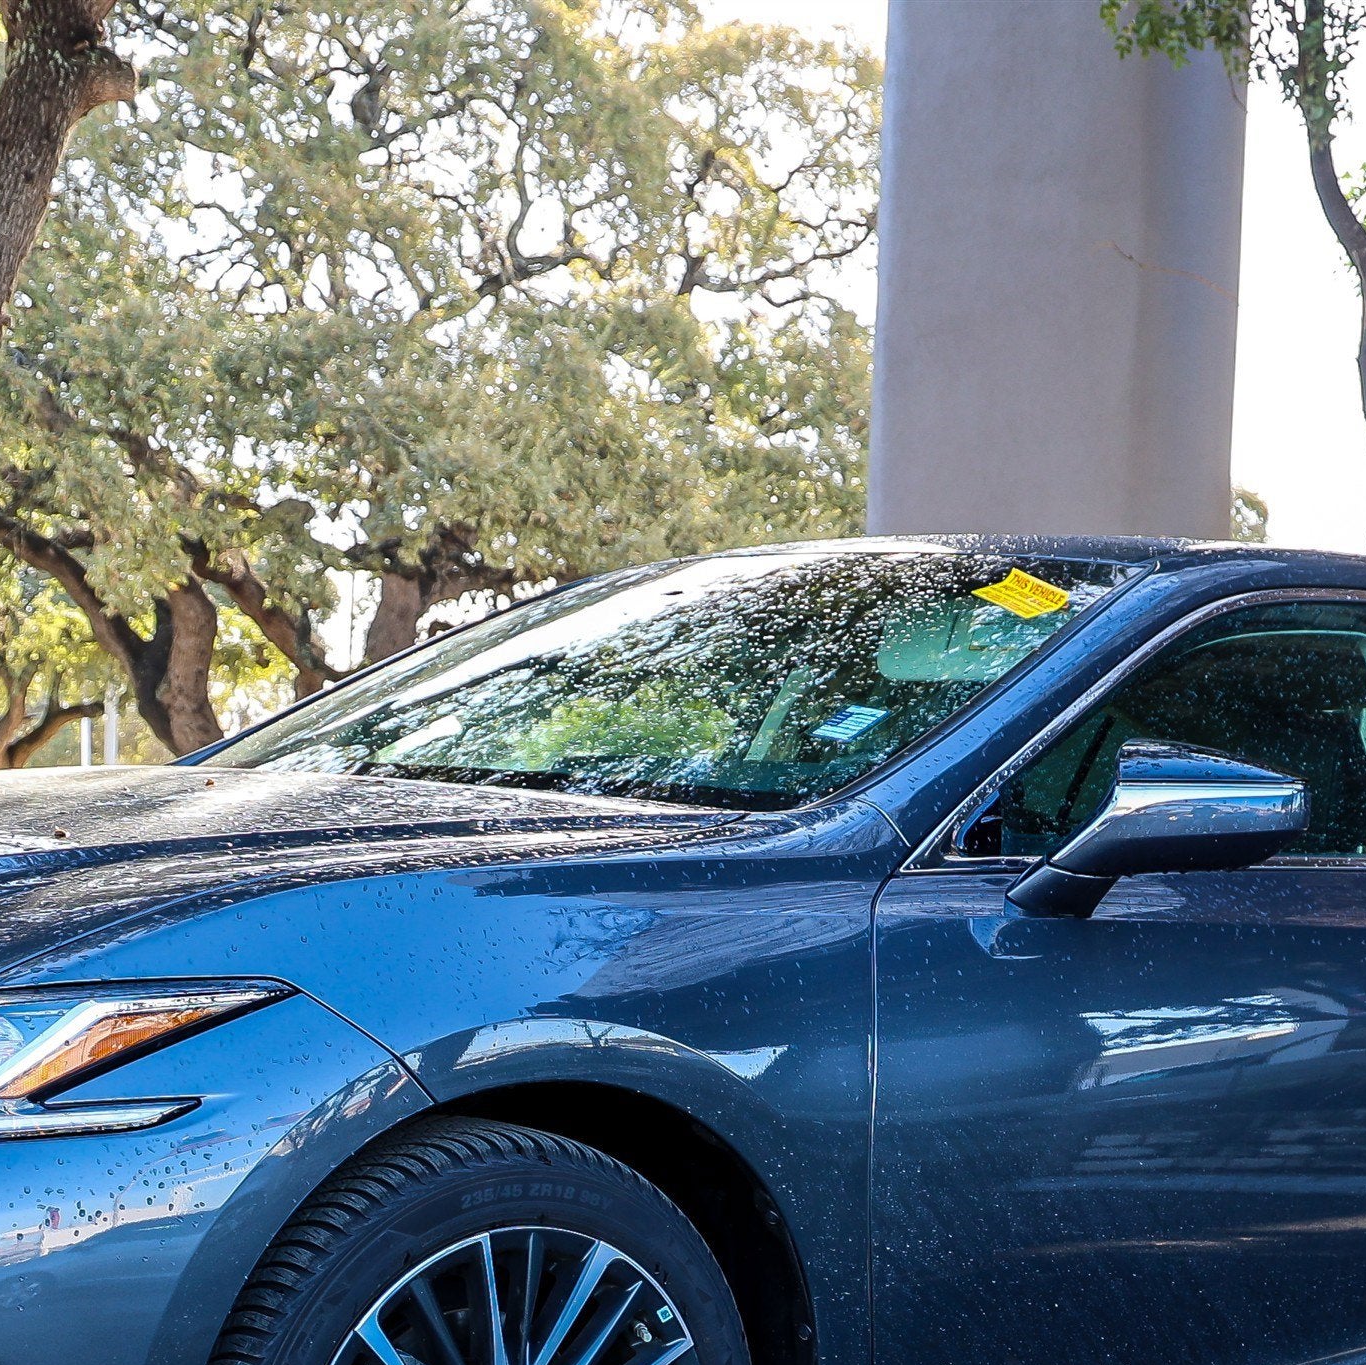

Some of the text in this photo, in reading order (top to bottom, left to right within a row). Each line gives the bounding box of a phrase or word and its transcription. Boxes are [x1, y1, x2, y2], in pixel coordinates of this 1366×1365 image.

[1009, 573, 1031, 589] THIS
[1029, 582, 1066, 605] VEHICLE
[461, 1183, 524, 1210] 235/45
[528, 1182, 577, 1200] ZR18
